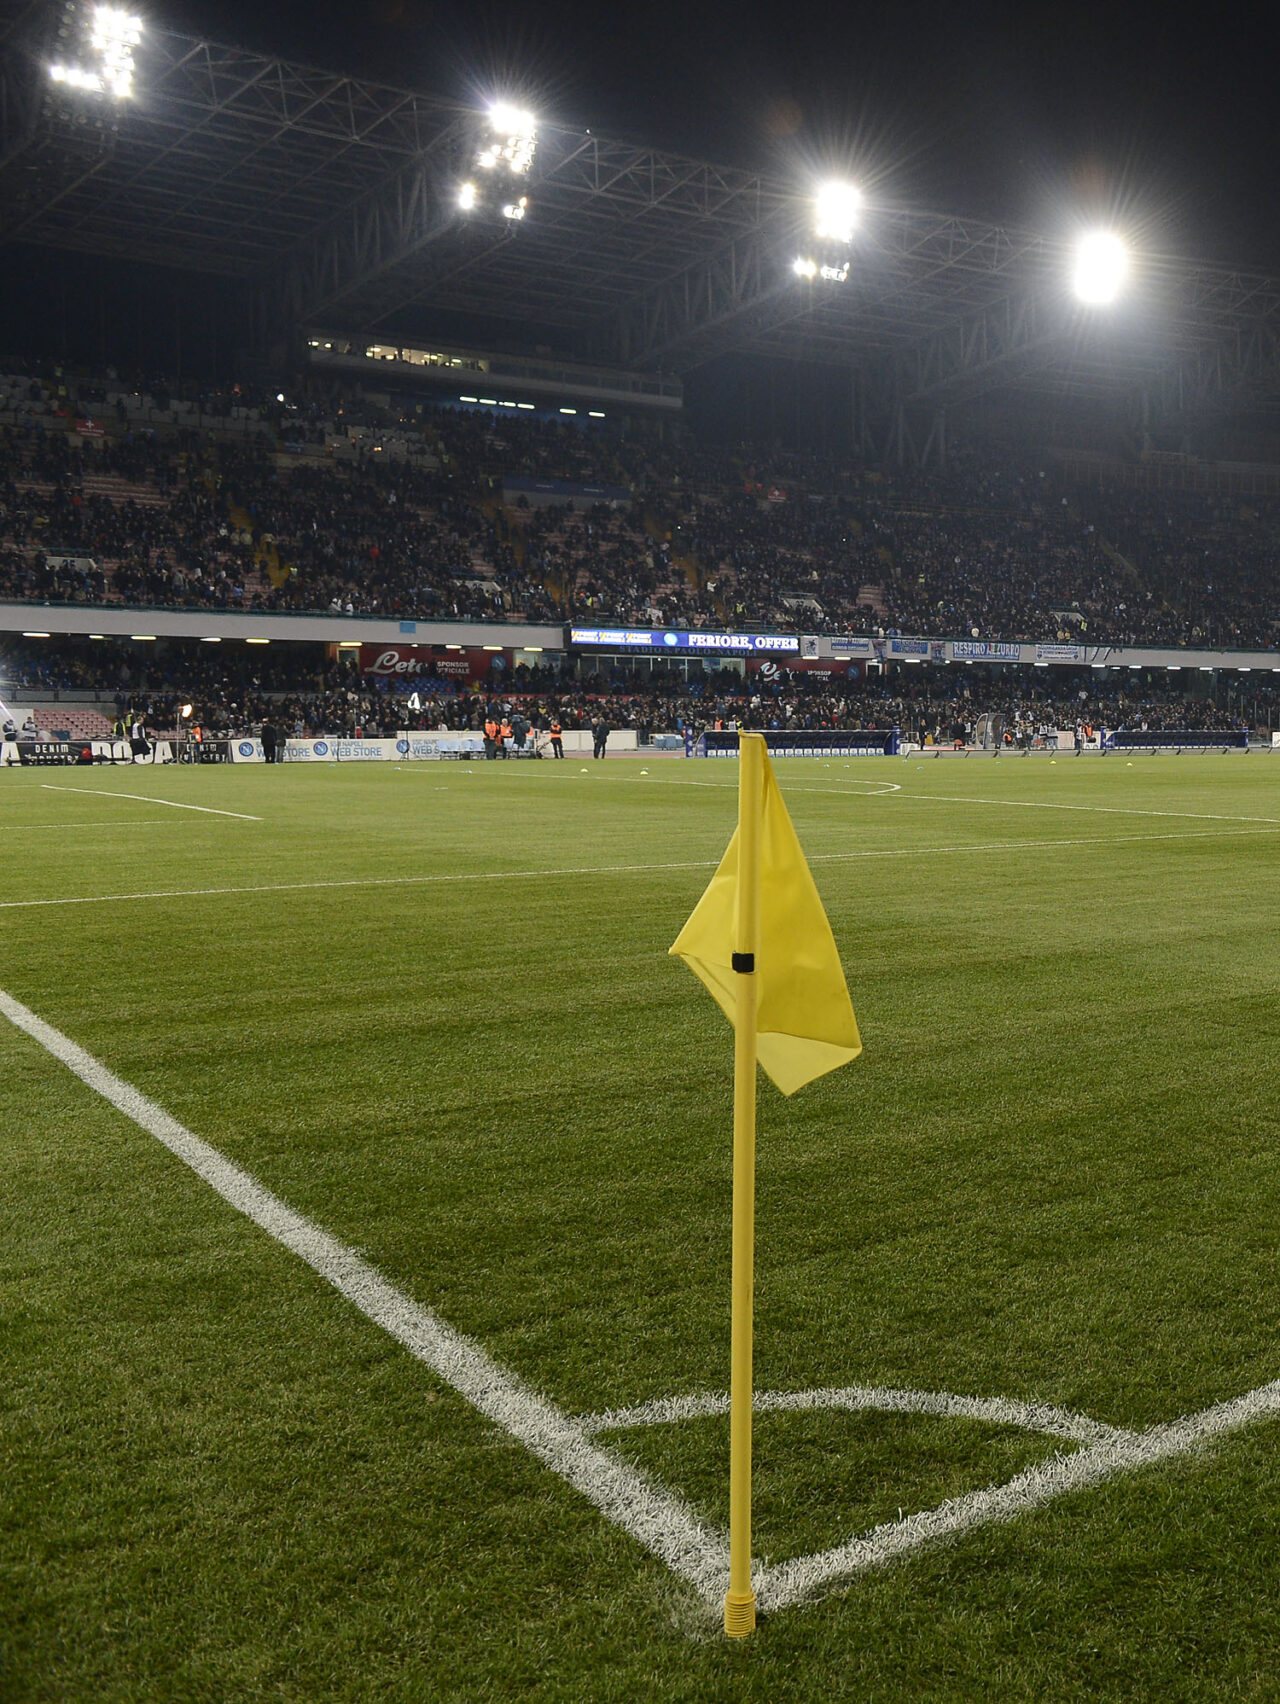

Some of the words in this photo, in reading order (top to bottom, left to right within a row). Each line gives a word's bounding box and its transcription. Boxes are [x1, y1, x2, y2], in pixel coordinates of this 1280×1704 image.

[688, 634, 754, 650] FERIORE,
[755, 637, 799, 649] OFFER
[620, 645, 661, 654] STADIO
[35, 744, 69, 753] DENIM
[330, 748, 351, 757] WEB
[353, 747, 382, 756] STORE
[412, 746, 433, 755] WEB
